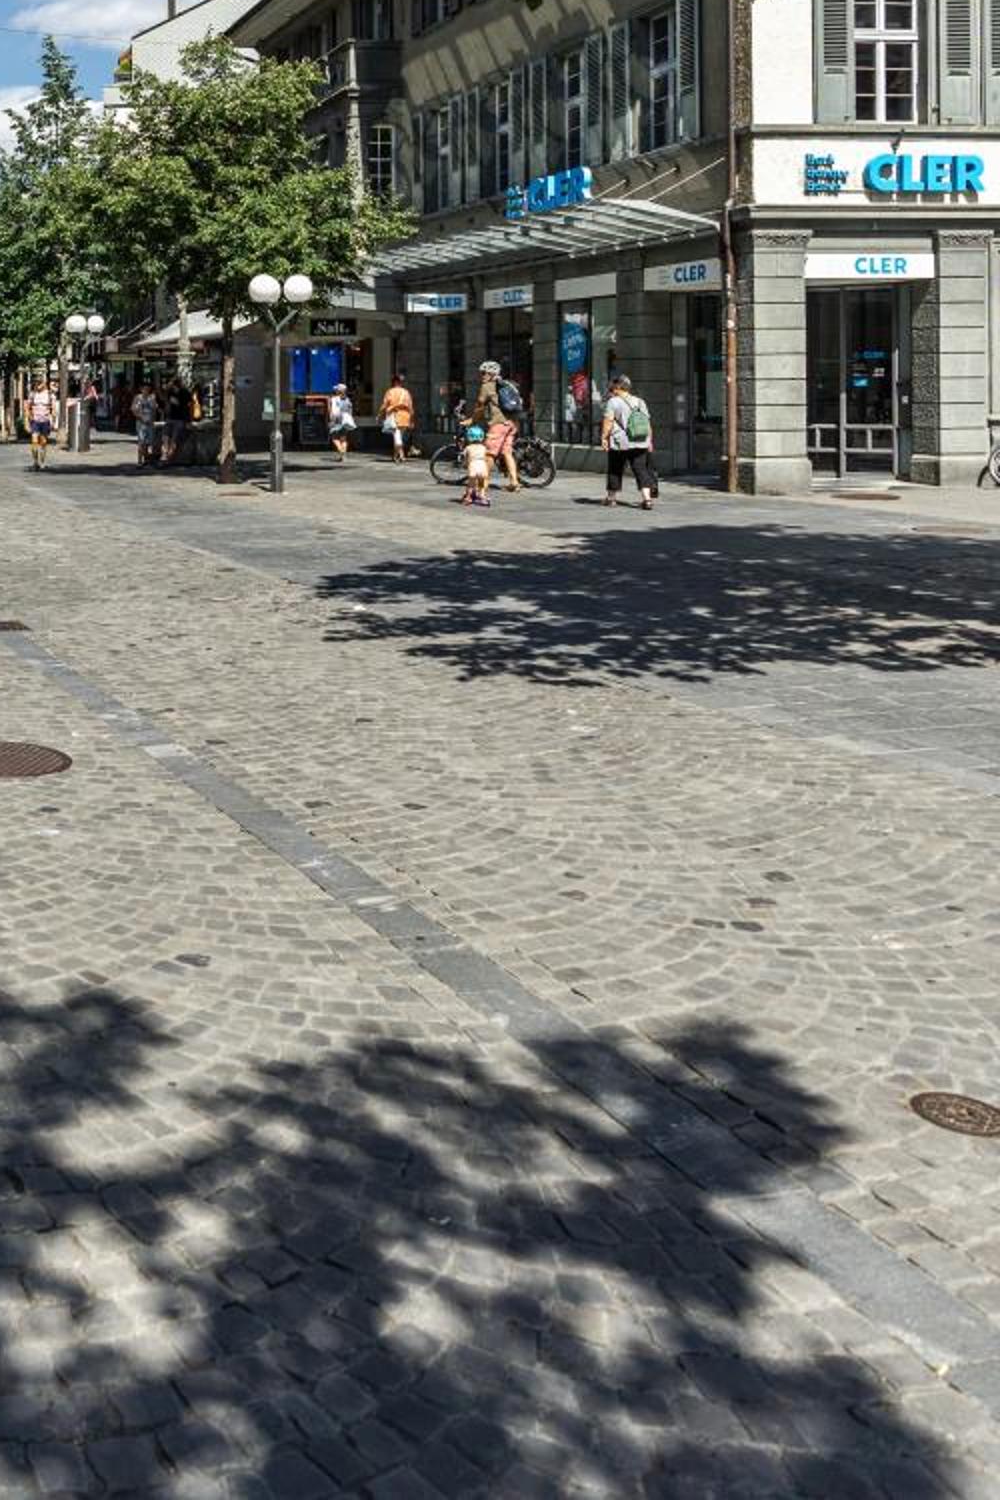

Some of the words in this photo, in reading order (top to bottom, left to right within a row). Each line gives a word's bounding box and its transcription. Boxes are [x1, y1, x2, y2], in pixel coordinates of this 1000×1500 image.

[864, 154, 985, 192] CLER
[528, 166, 593, 213] CLER
[674, 263, 707, 283] CLER
[855, 257, 907, 275] CLER
[429, 296, 463, 309] CLER
